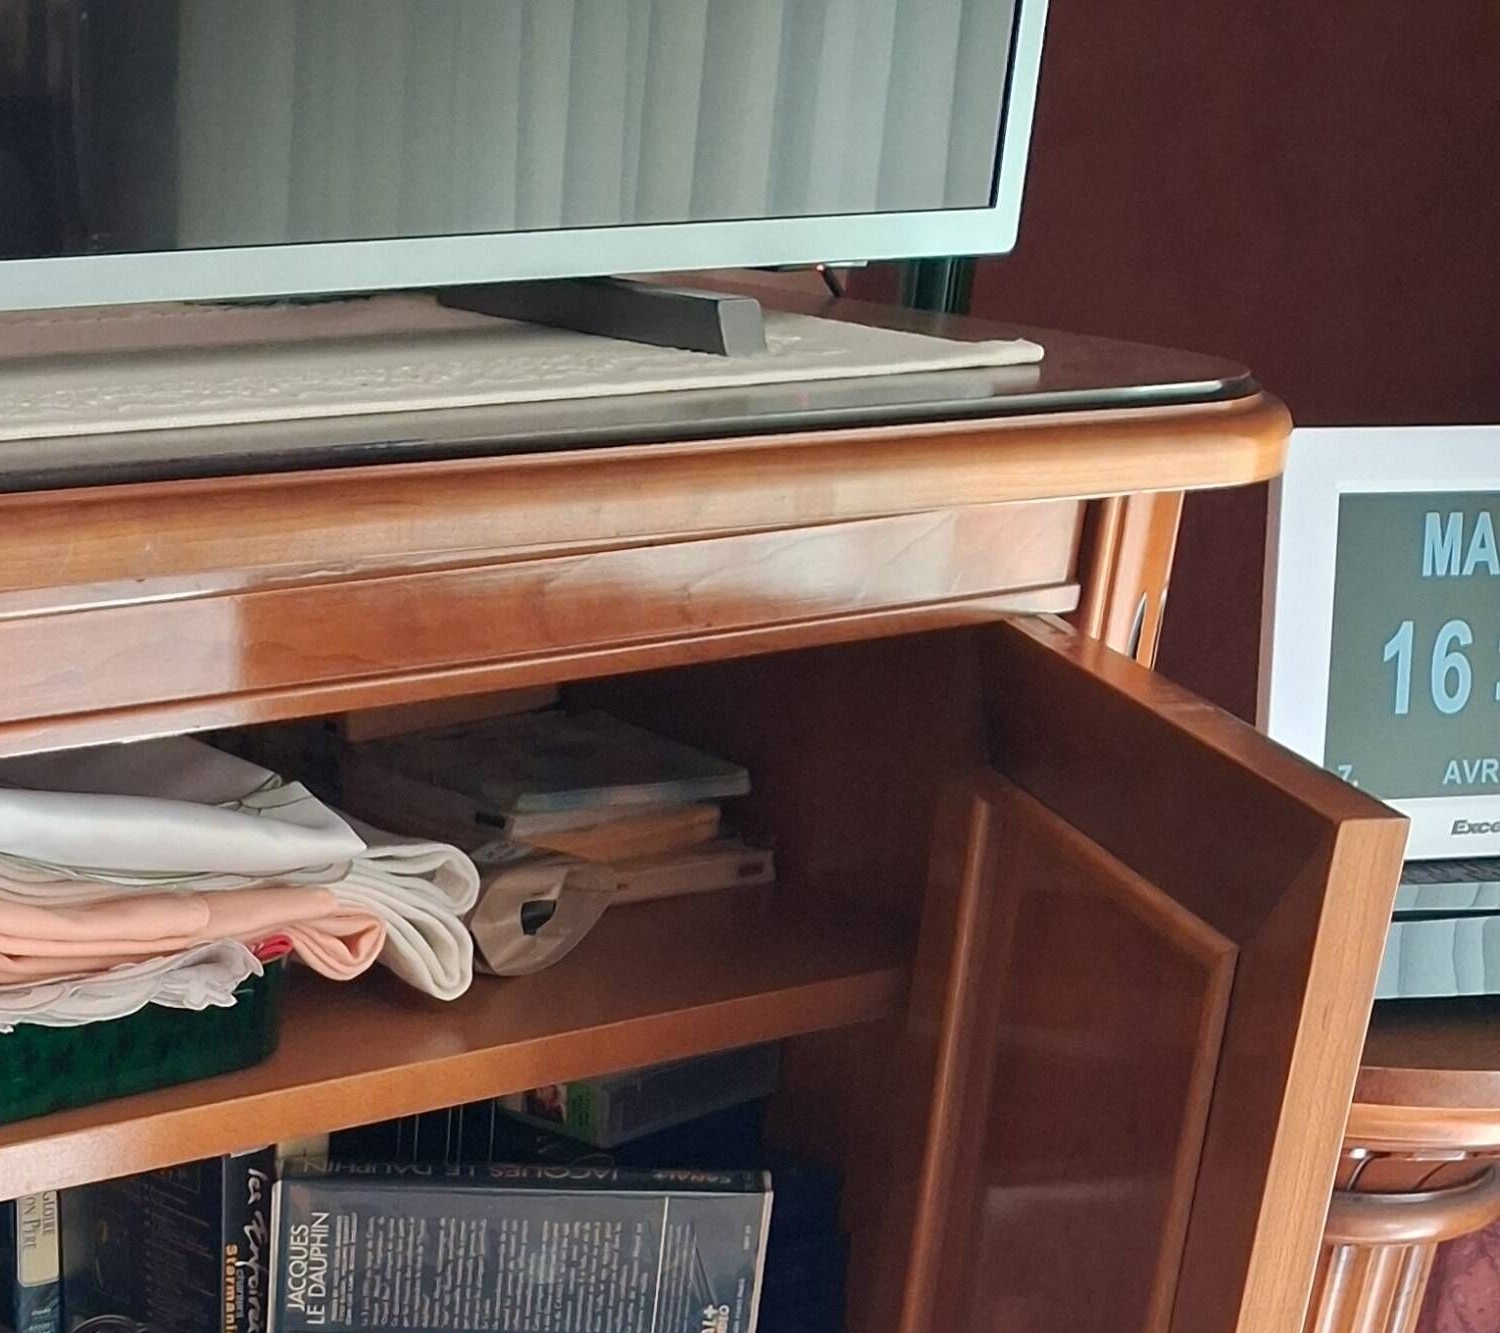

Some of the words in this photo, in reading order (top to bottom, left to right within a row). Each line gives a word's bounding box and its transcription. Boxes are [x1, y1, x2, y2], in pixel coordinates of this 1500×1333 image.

[303, 1160, 433, 1177] DAUPHIN
[446, 1164, 477, 1178] LE
[490, 1165, 619, 1181] JACQUES
[308, 1212, 331, 1299] DAUPHIN
[287, 1224, 310, 1312] JACQUES
[306, 1304, 326, 1326] LE
